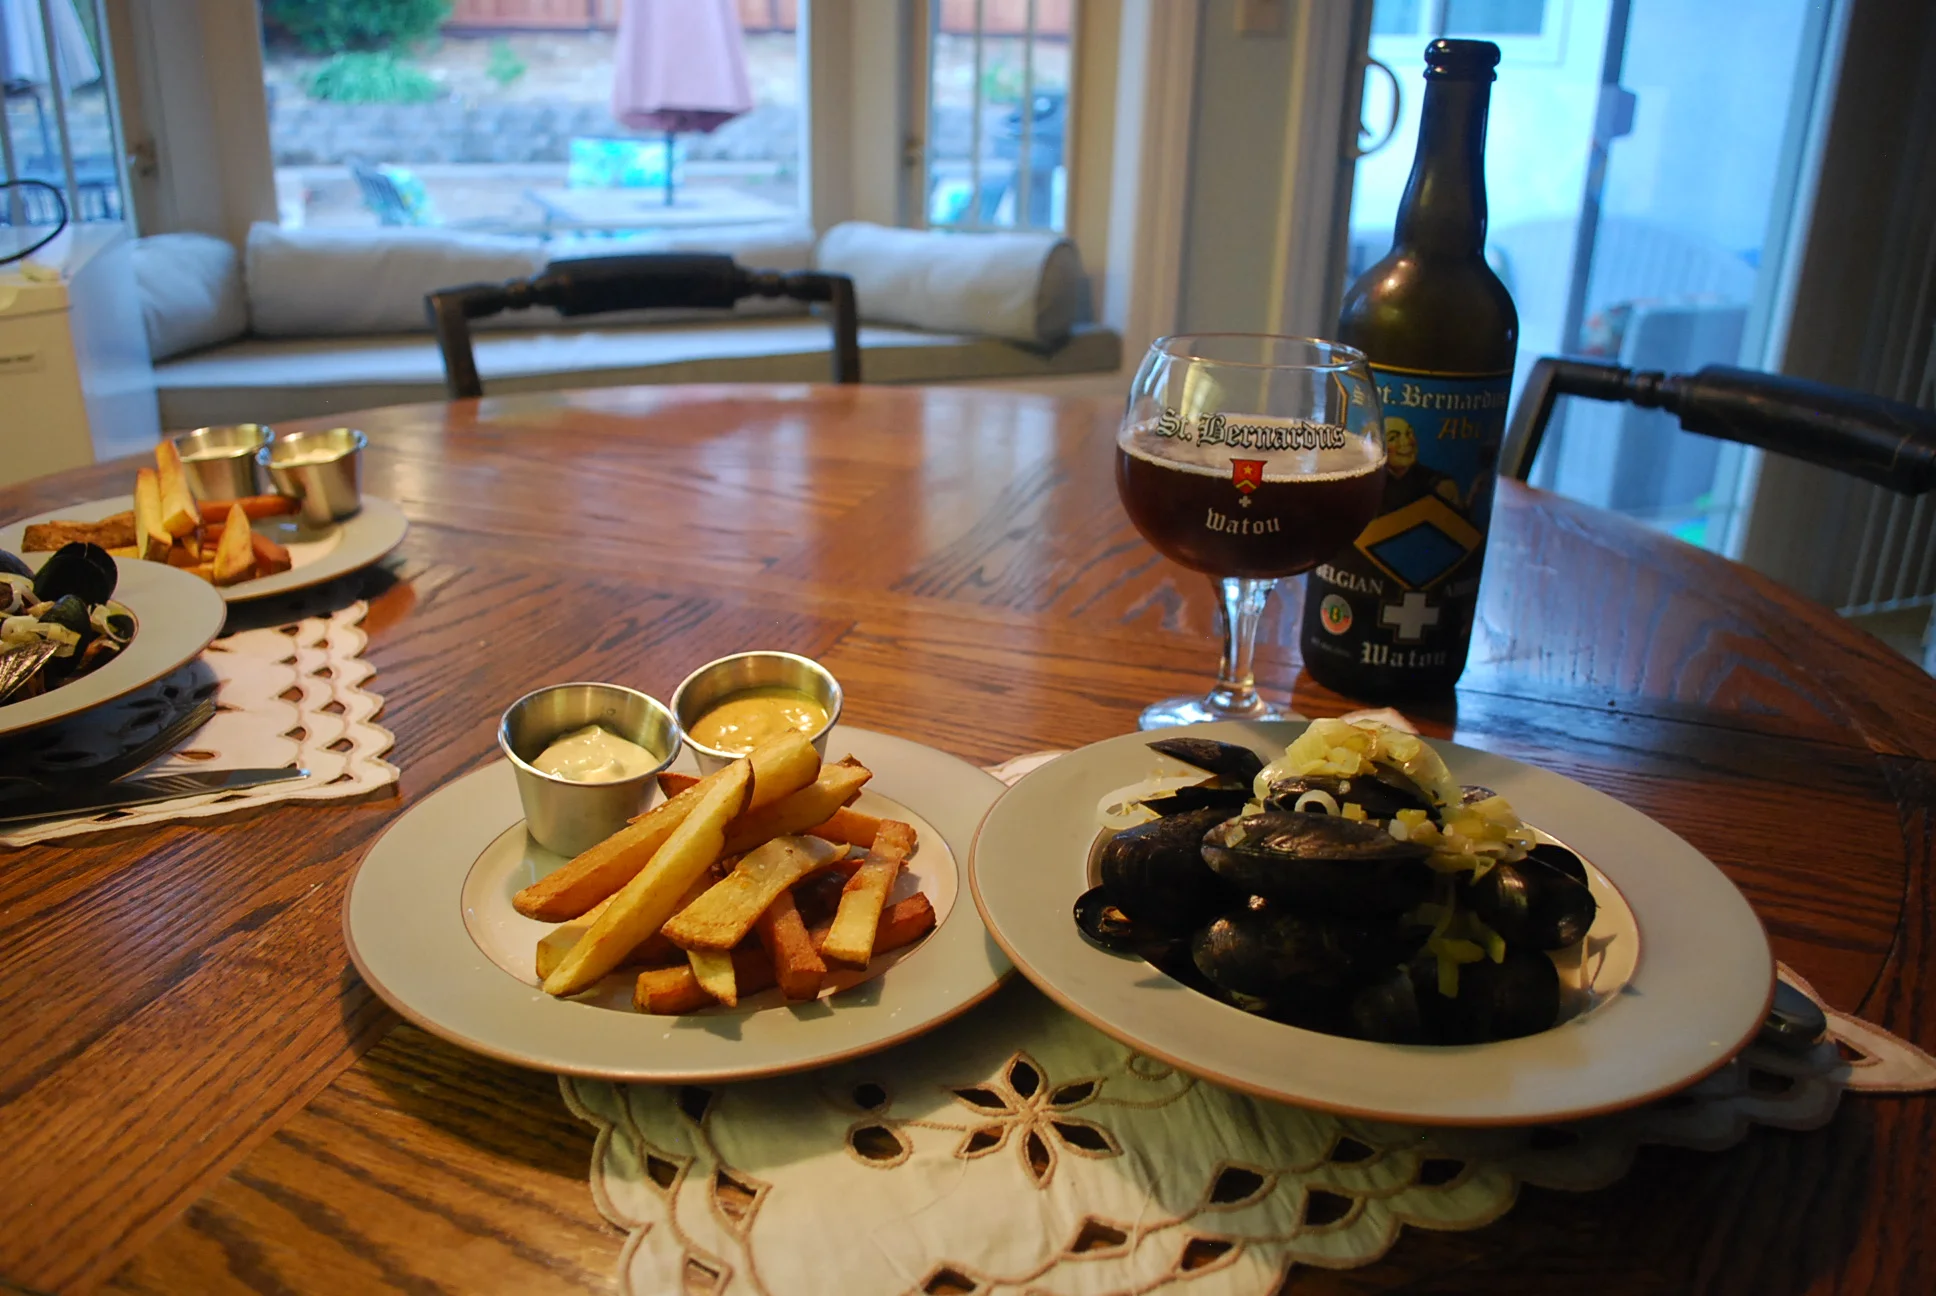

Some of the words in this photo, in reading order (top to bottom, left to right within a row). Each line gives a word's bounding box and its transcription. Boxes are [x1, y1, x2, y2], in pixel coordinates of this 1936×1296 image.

[1156, 407, 1192, 441] St.
[1197, 412, 1346, 450] Bernardus
[1205, 507, 1281, 535] Watou
[1360, 641, 1447, 668] Watou
